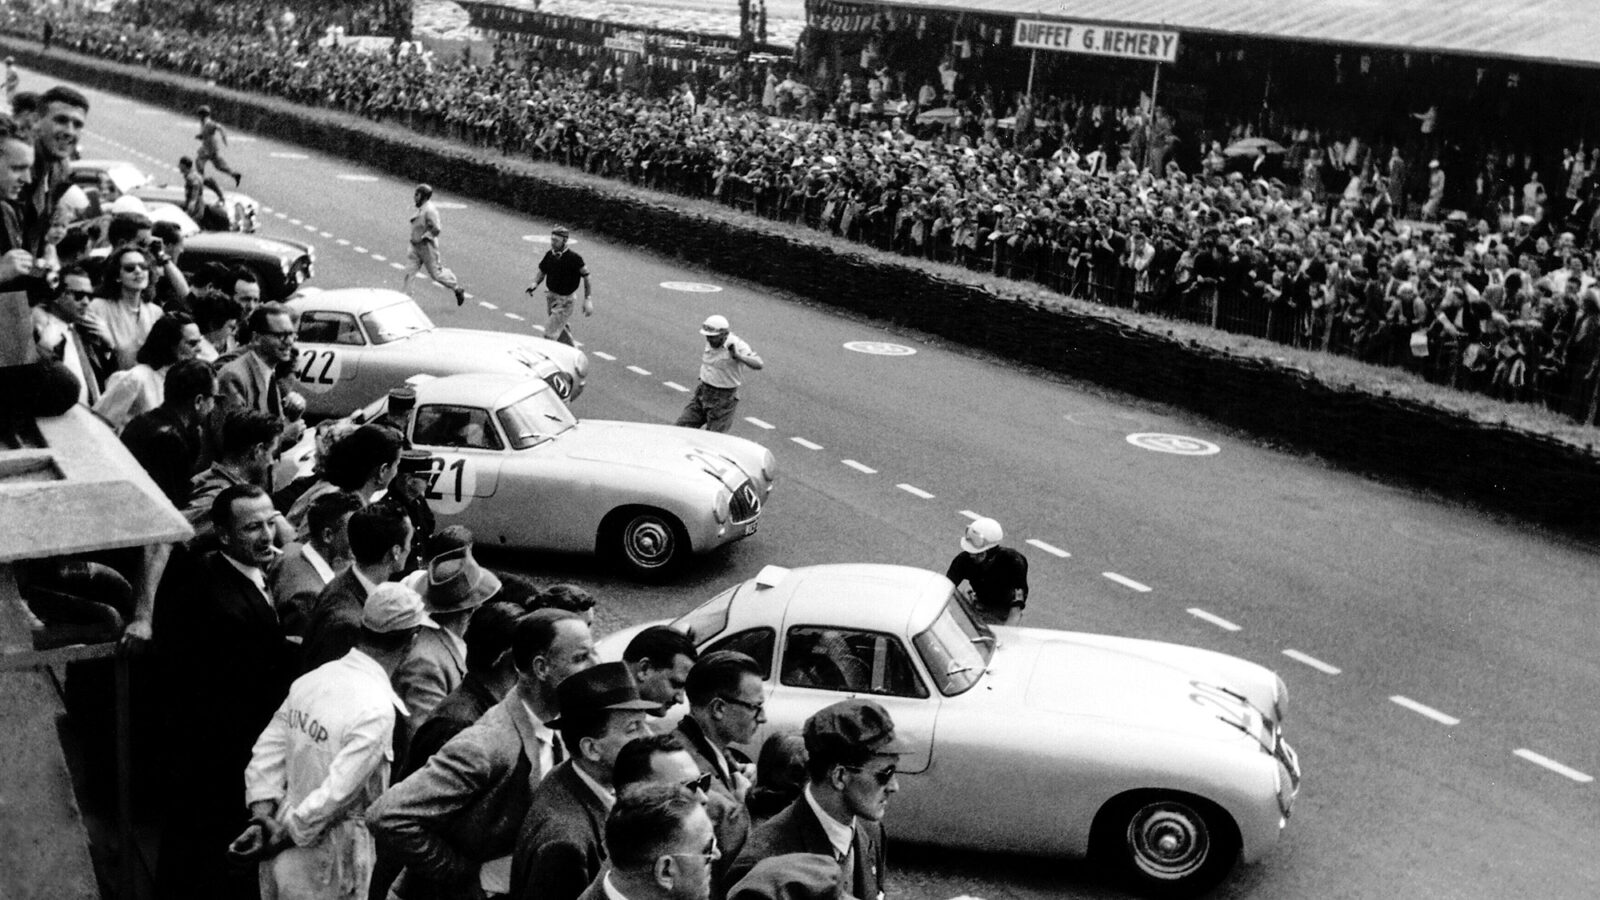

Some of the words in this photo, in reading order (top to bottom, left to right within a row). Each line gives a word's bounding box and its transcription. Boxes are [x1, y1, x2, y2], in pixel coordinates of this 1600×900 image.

[1018, 22, 1073, 48] BUFFET
[300, 349, 336, 385] 22
[424, 457, 466, 503] 21
